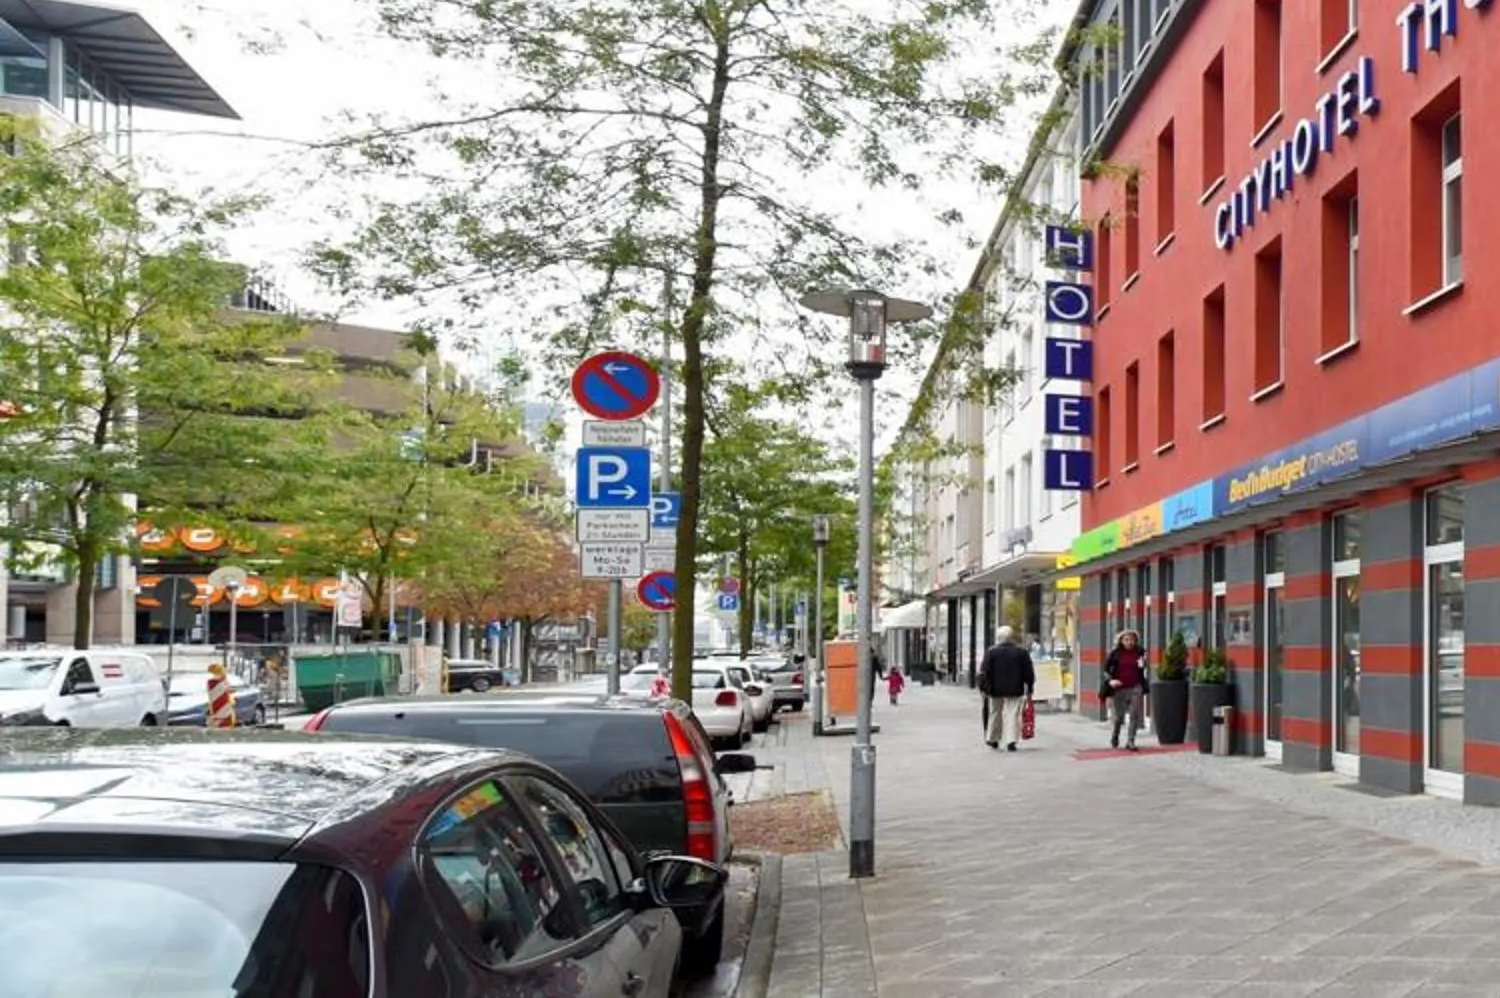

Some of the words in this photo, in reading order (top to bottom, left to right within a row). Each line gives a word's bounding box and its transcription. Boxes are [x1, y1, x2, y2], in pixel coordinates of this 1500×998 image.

[1215, 55, 1380, 250] CITYHOTEL
[1049, 228, 1089, 487] HOTEL
[588, 454, 628, 501] P
